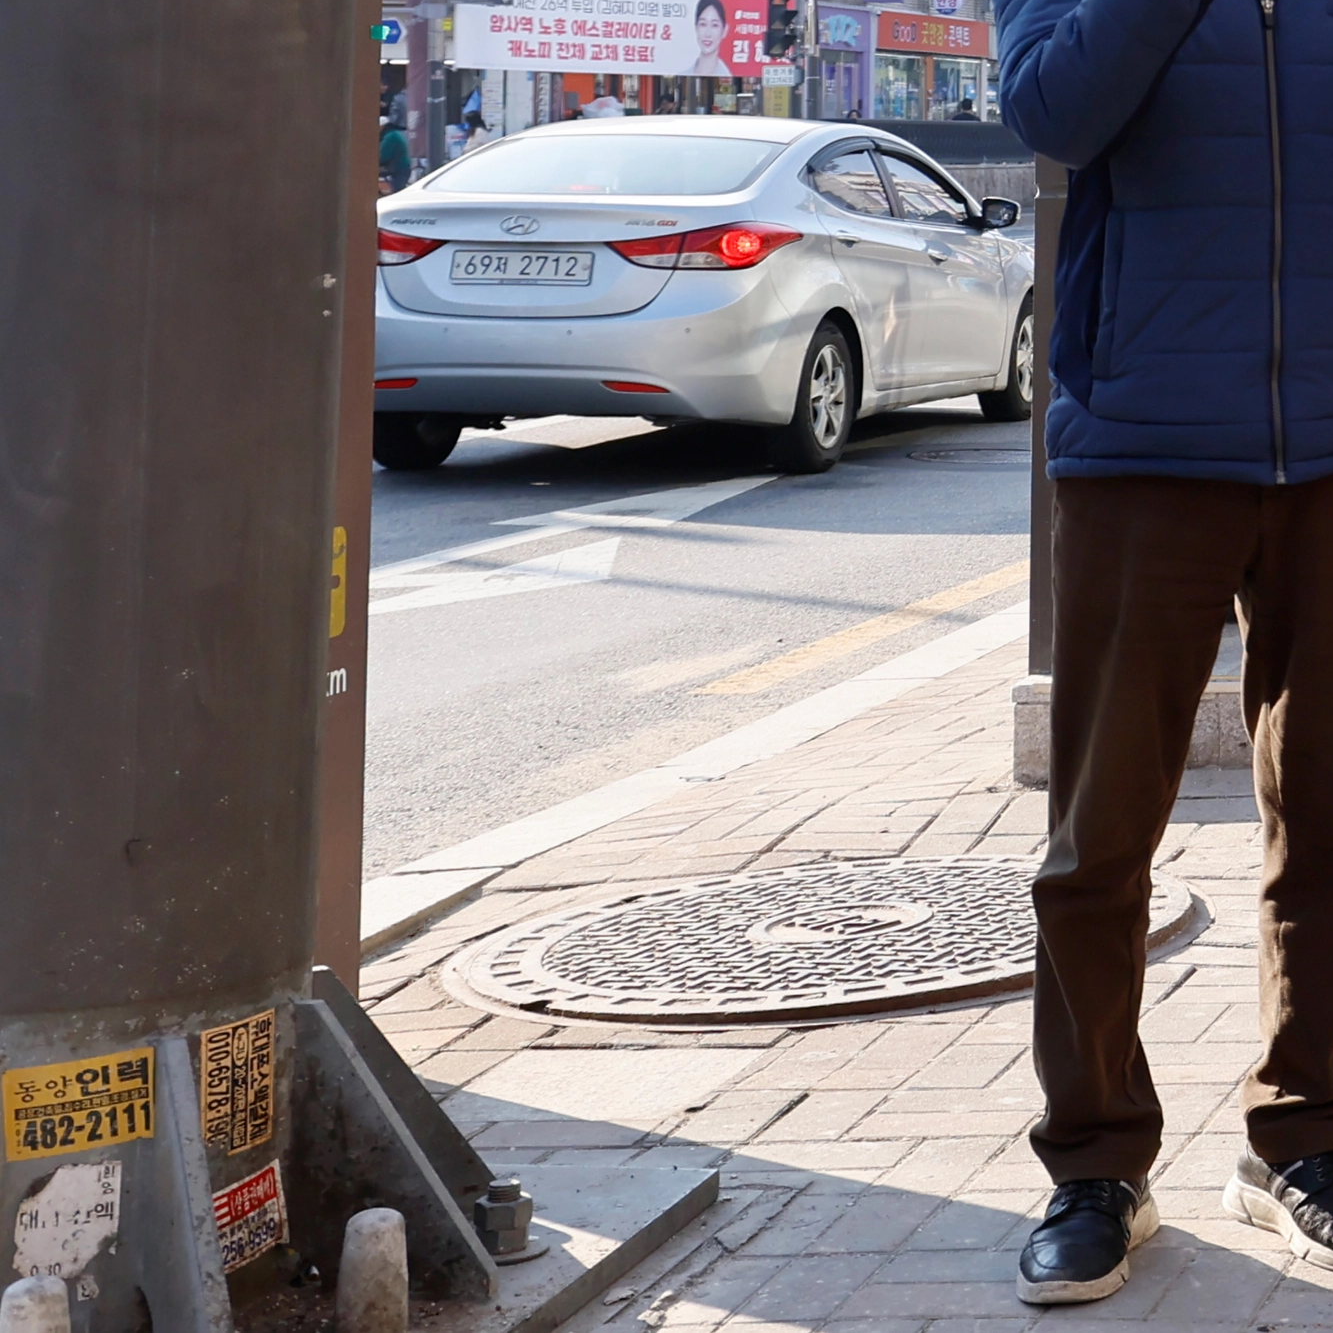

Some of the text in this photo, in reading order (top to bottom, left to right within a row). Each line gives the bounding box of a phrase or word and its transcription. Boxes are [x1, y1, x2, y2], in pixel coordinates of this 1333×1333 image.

[571, 0, 593, 13] 투입
[638, 1, 659, 17] 의원
[662, 2, 687, 18] 발의)
[490, 14, 672, 40] 암사역 노후 에스컬레이터 &
[507, 40, 655, 63] 캐노피 전체 교체 완료!
[519, 255, 578, 276] 2712
[326, 667, 347, 697] m
[249, 1017, 272, 1141] 휴대폰소액결제
[23, 1101, 151, 1151] 482-2111
